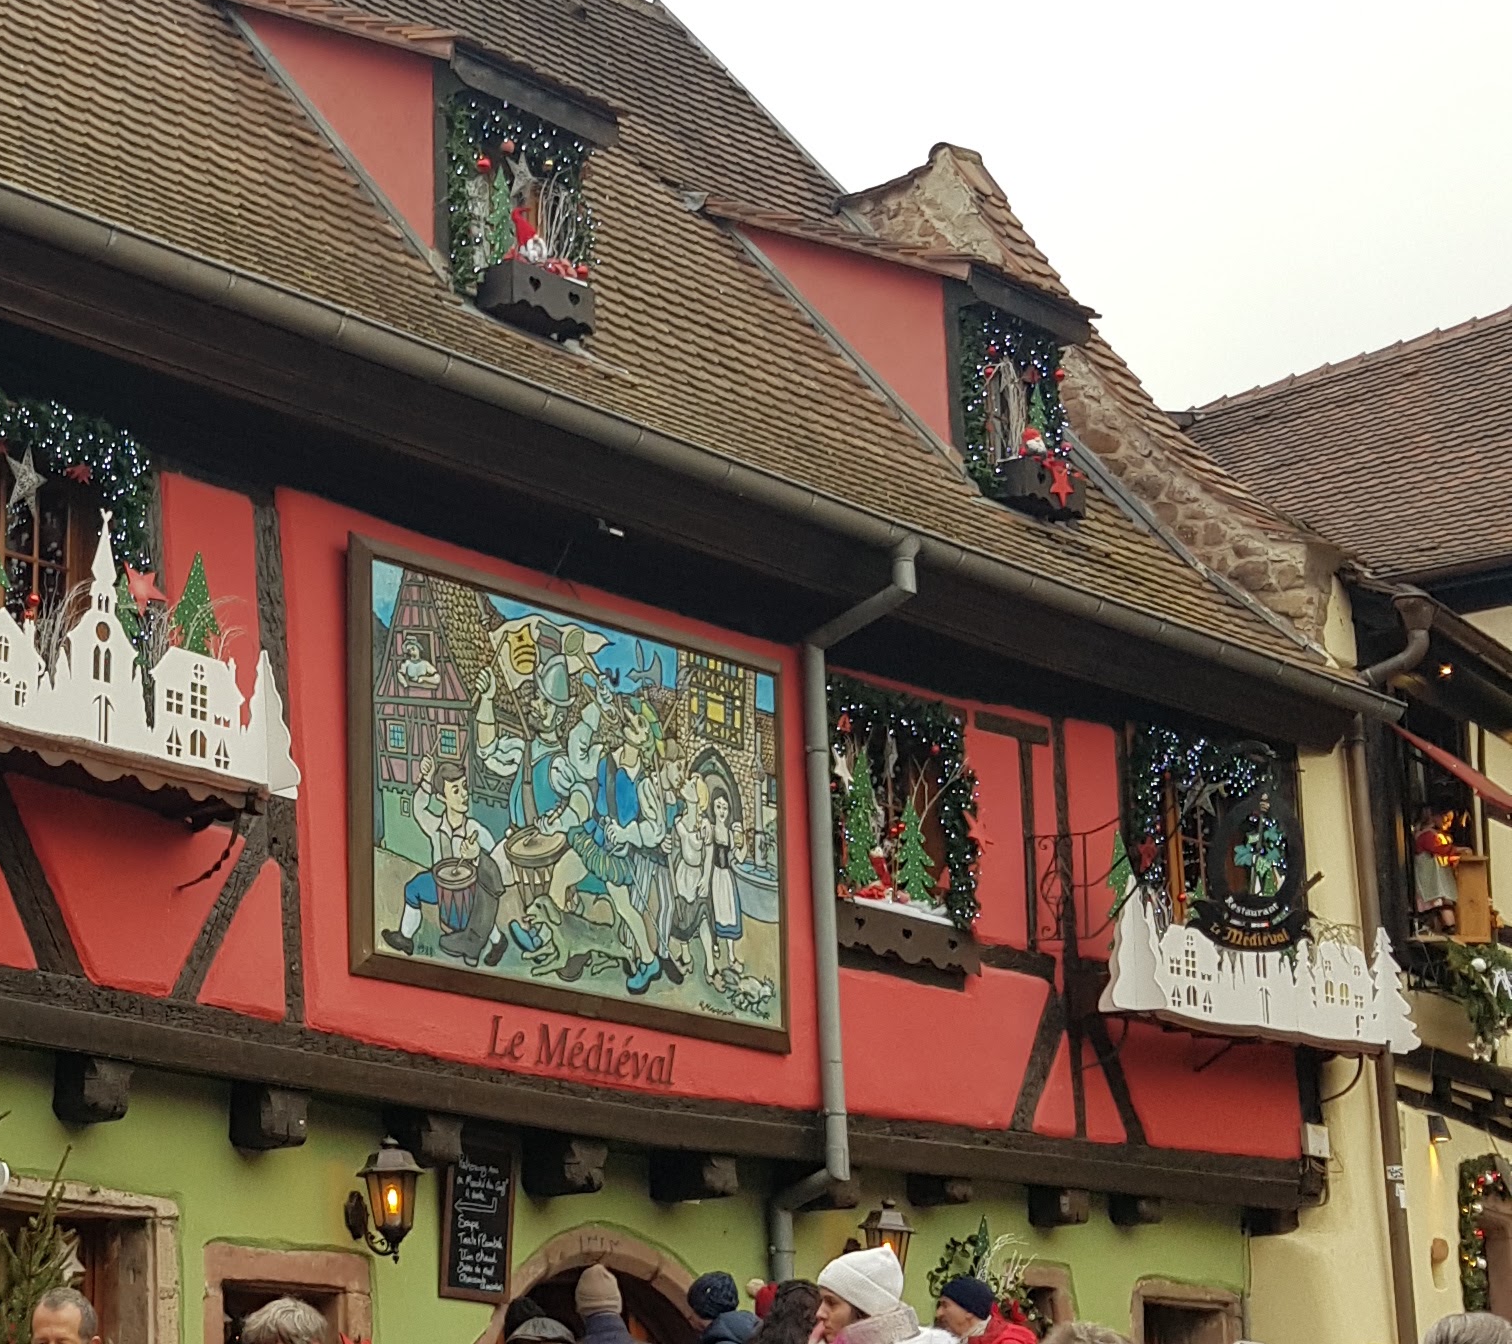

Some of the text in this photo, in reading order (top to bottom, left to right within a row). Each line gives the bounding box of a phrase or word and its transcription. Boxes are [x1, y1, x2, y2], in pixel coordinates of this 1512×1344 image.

[1224, 896, 1280, 917] Restaurant
[488, 1014, 676, 1086] Le Médiéval
